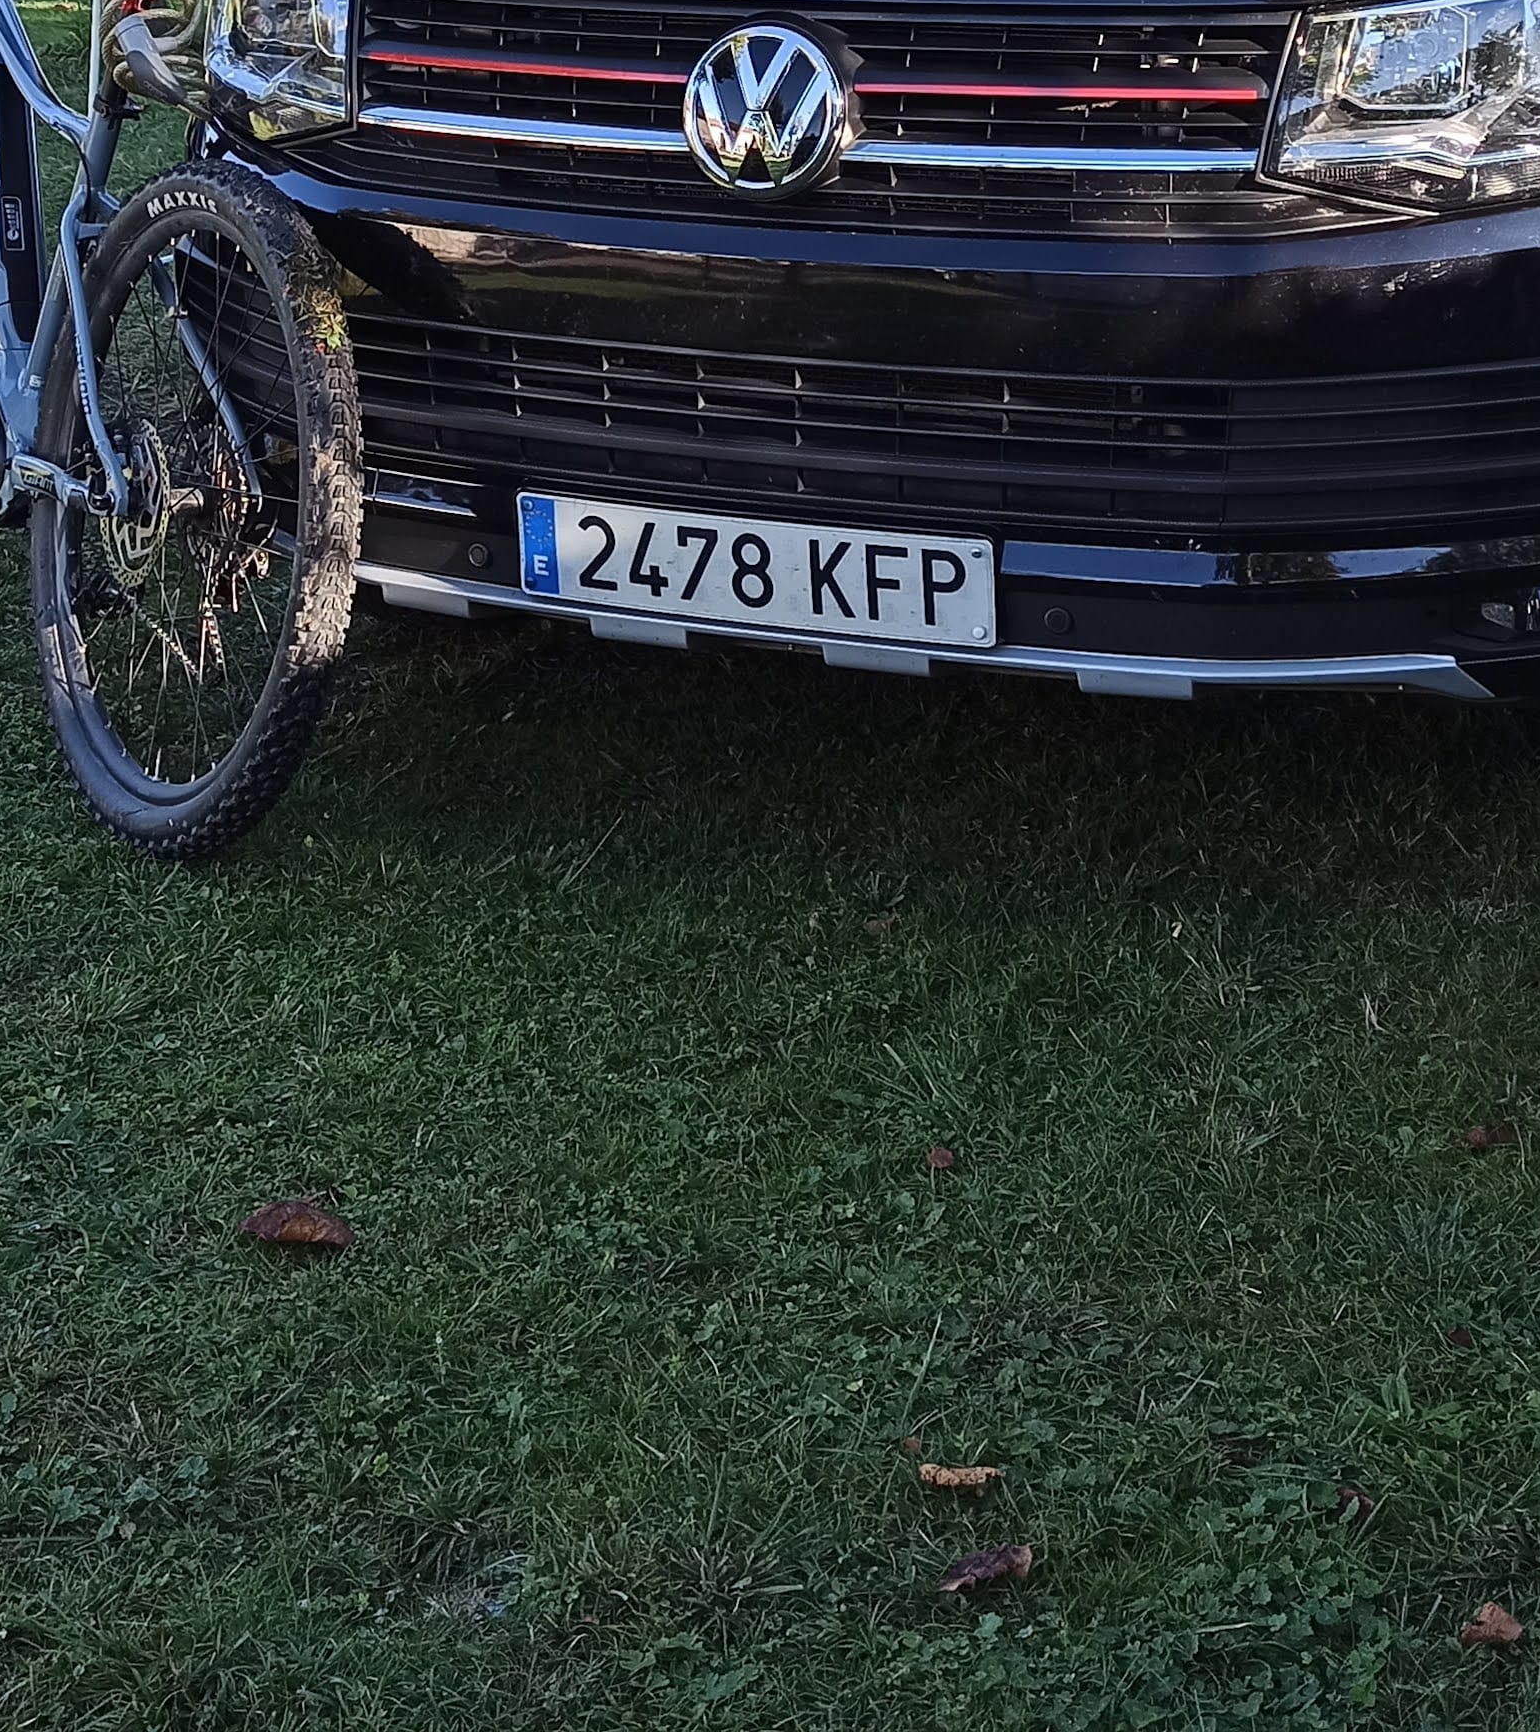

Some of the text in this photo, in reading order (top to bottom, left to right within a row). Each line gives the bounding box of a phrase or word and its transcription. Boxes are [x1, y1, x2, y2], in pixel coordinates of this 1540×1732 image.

[688, 29, 840, 194] VW
[146, 190, 218, 219] MAXXIS
[533, 554, 550, 576] E
[577, 515, 967, 627] 2478 KFP
